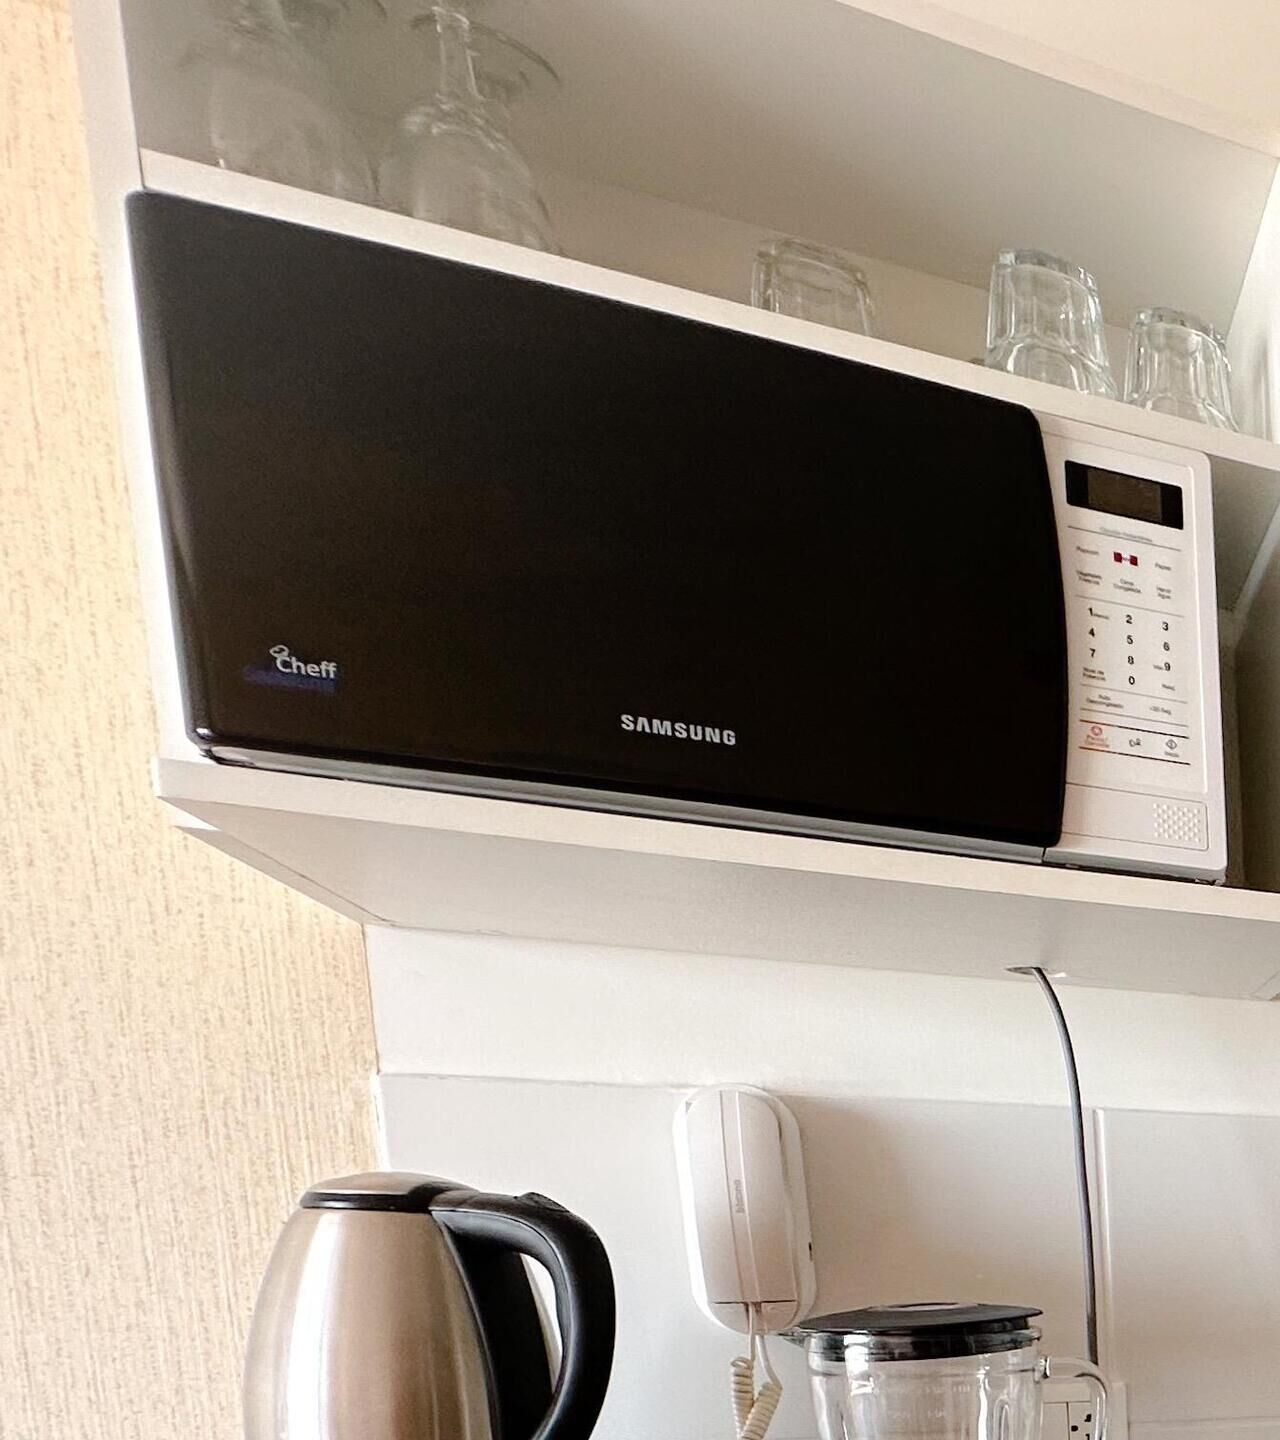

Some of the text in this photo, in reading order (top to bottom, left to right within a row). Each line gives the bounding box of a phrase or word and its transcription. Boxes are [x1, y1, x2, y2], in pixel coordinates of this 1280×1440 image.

[1125, 614, 1133, 624] 2
[1162, 622, 1169, 631] 3
[1088, 628, 1095, 637] 4
[1126, 635, 1133, 645] 5
[1163, 642, 1170, 651] 6
[1089, 648, 1096, 658] 7
[1127, 655, 1135, 665] 8
[275, 656, 338, 679] Cheff
[1164, 662, 1171, 671] 9
[620, 714, 737, 746] SAMSUNG
